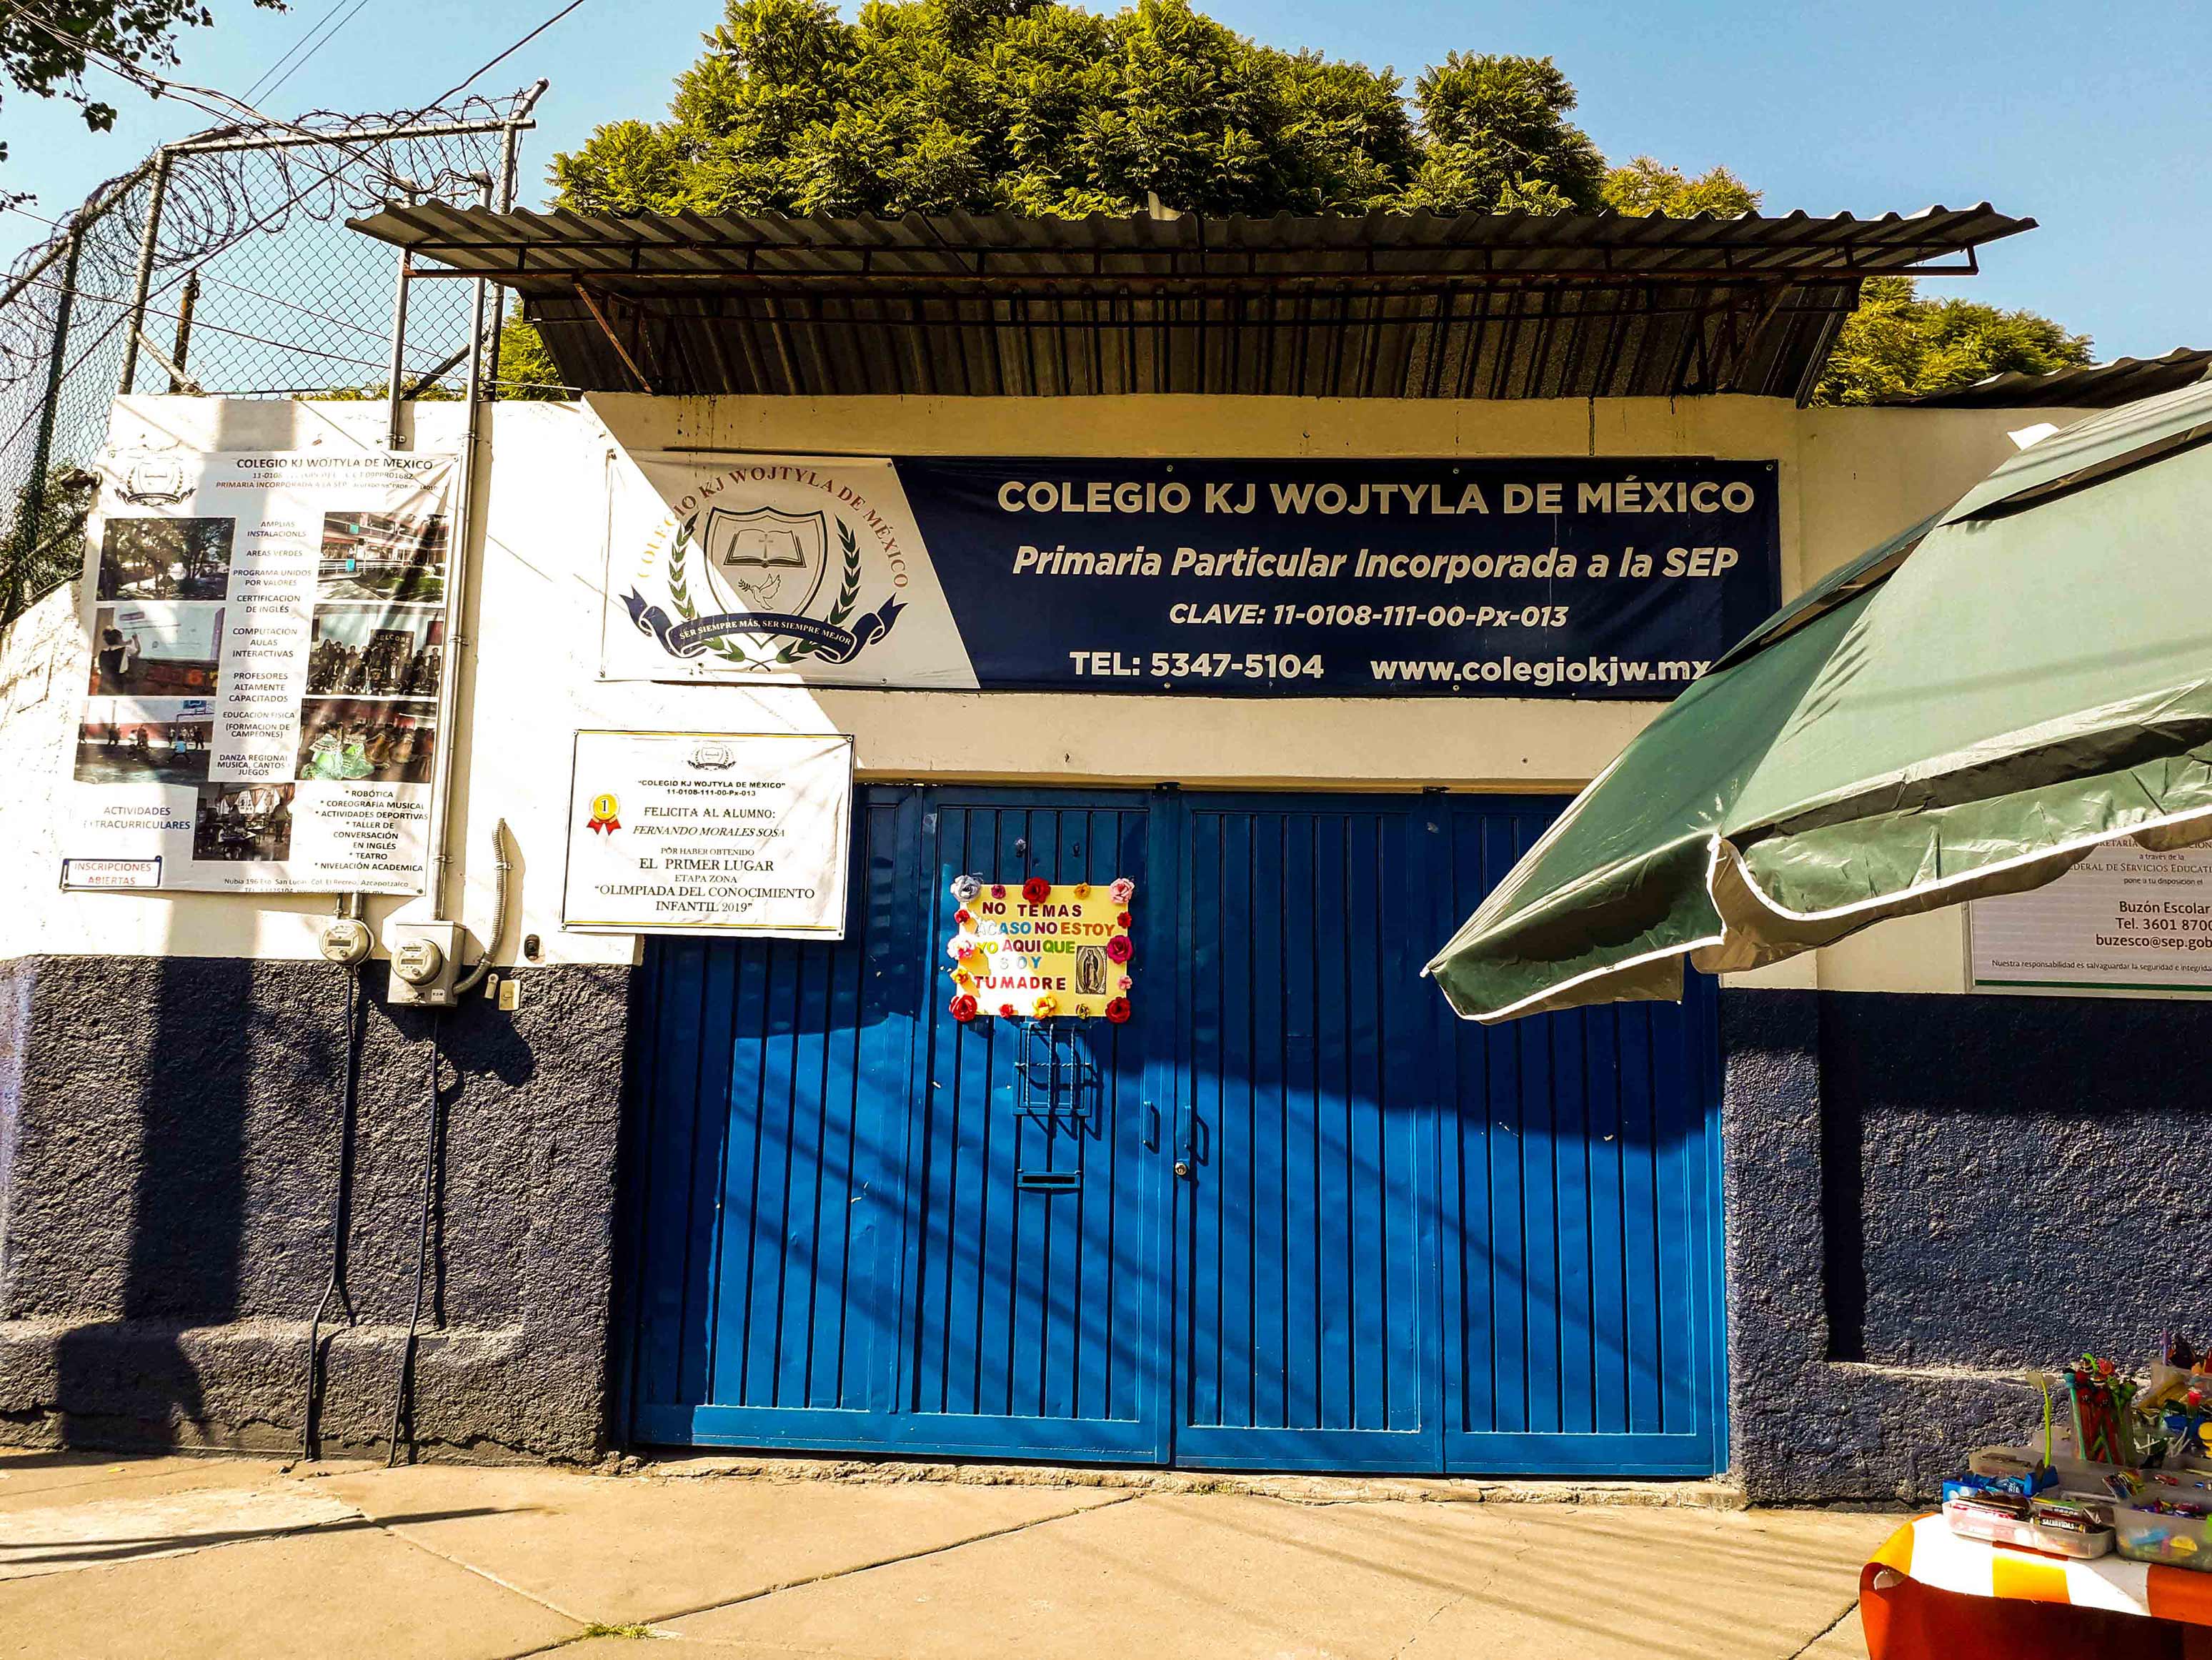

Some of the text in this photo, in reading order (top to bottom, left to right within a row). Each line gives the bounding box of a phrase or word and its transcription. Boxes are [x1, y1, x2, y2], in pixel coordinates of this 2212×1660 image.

[237, 459, 287, 468] COLEGIO
[292, 459, 303, 467] KJ
[307, 458, 360, 467] WOJTYLA
[364, 459, 379, 467] DE
[997, 474, 1755, 515] COLEGIO KJ WOJTYLA DE MÉXICO
[699, 477, 724, 499] KJ
[729, 467, 833, 493] WOJTYLA
[837, 485, 866, 511] DE
[862, 509, 908, 588] MÉXICO
[1012, 545, 1738, 583] Primaria Particular Incorporada a la SEP
[259, 605, 289, 613] INGLÉS
[1169, 604, 1569, 627] CLAVE: 11-0108-111-00-Px-013
[679, 630, 697, 640] SER
[698, 621, 737, 636] SIEMPRE
[762, 620, 779, 628] SER
[781, 622, 821, 635] SIEMPRE
[822, 627, 852, 645] MEJOR
[1069, 651, 1711, 687] TEL: 5347-5104 www.colegiokjw.mx
[352, 789, 393, 797] ROBÓTICA
[104, 807, 171, 815] ACTIVIDADES
[601, 799, 608, 812] 1
[644, 807, 775, 818] FELICITA AL ALUMNO:
[334, 831, 399, 840] CONVERSACIÓN
[633, 825, 784, 838] FERNANDO MORALES SOSA
[367, 841, 396, 850] INGLÉS
[74, 863, 151, 872] INSCRIPCIONES
[372, 863, 423, 871] ACADEMICA
[639, 858, 774, 872] EL PRIMER LUGAR
[88, 876, 136, 885] ABIERTAS
[361, 880, 409, 888] Azcapotzalco
[679, 887, 705, 897] DEL
[708, 887, 815, 899] CONOCIMIENTO
[656, 900, 719, 912] INFANTIL
[982, 902, 1082, 918] NO TEMAS
[2119, 900, 2211, 914] Buzón Escolar
[976, 920, 1115, 937] ACASO NO ESTOY
[2116, 918, 2138, 930] Tel.
[2143, 919, 2177, 930] 3601
[977, 939, 1075, 954] YO AQUI QUE
[1000, 956, 1042, 969] SOY
[2022, 960, 2075, 969] responsabilidad
[2086, 962, 2130, 972] salvaguardar
[2140, 963, 2173, 973] seguridad
[975, 975, 1067, 990] TU MADRE
